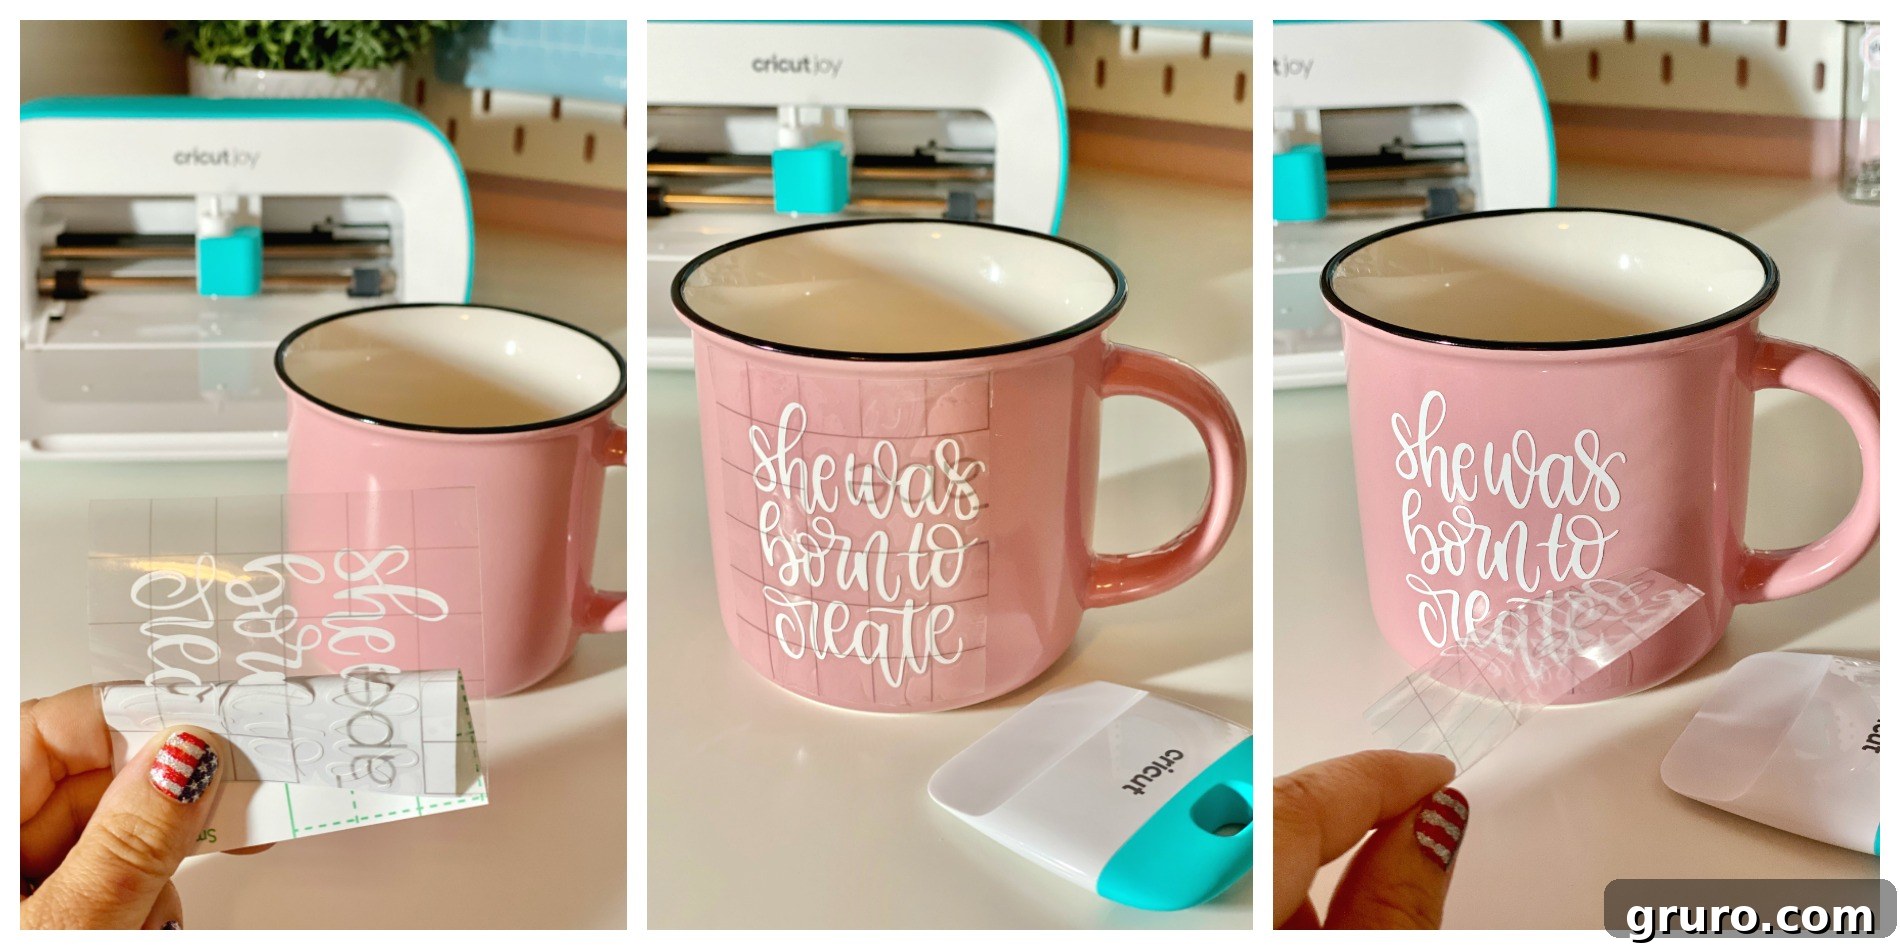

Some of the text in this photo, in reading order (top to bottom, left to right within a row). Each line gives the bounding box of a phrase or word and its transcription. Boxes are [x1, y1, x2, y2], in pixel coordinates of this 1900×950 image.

[751, 53, 844, 79] cricut joy
[172, 145, 261, 171] cricut joy
[749, 402, 986, 521] she was
[1391, 390, 1627, 513] she was
[759, 501, 979, 602] born to
[1402, 488, 1619, 592] born to
[322, 545, 449, 656] she
[762, 586, 964, 688] create
[1121, 749, 1184, 795] cricut
